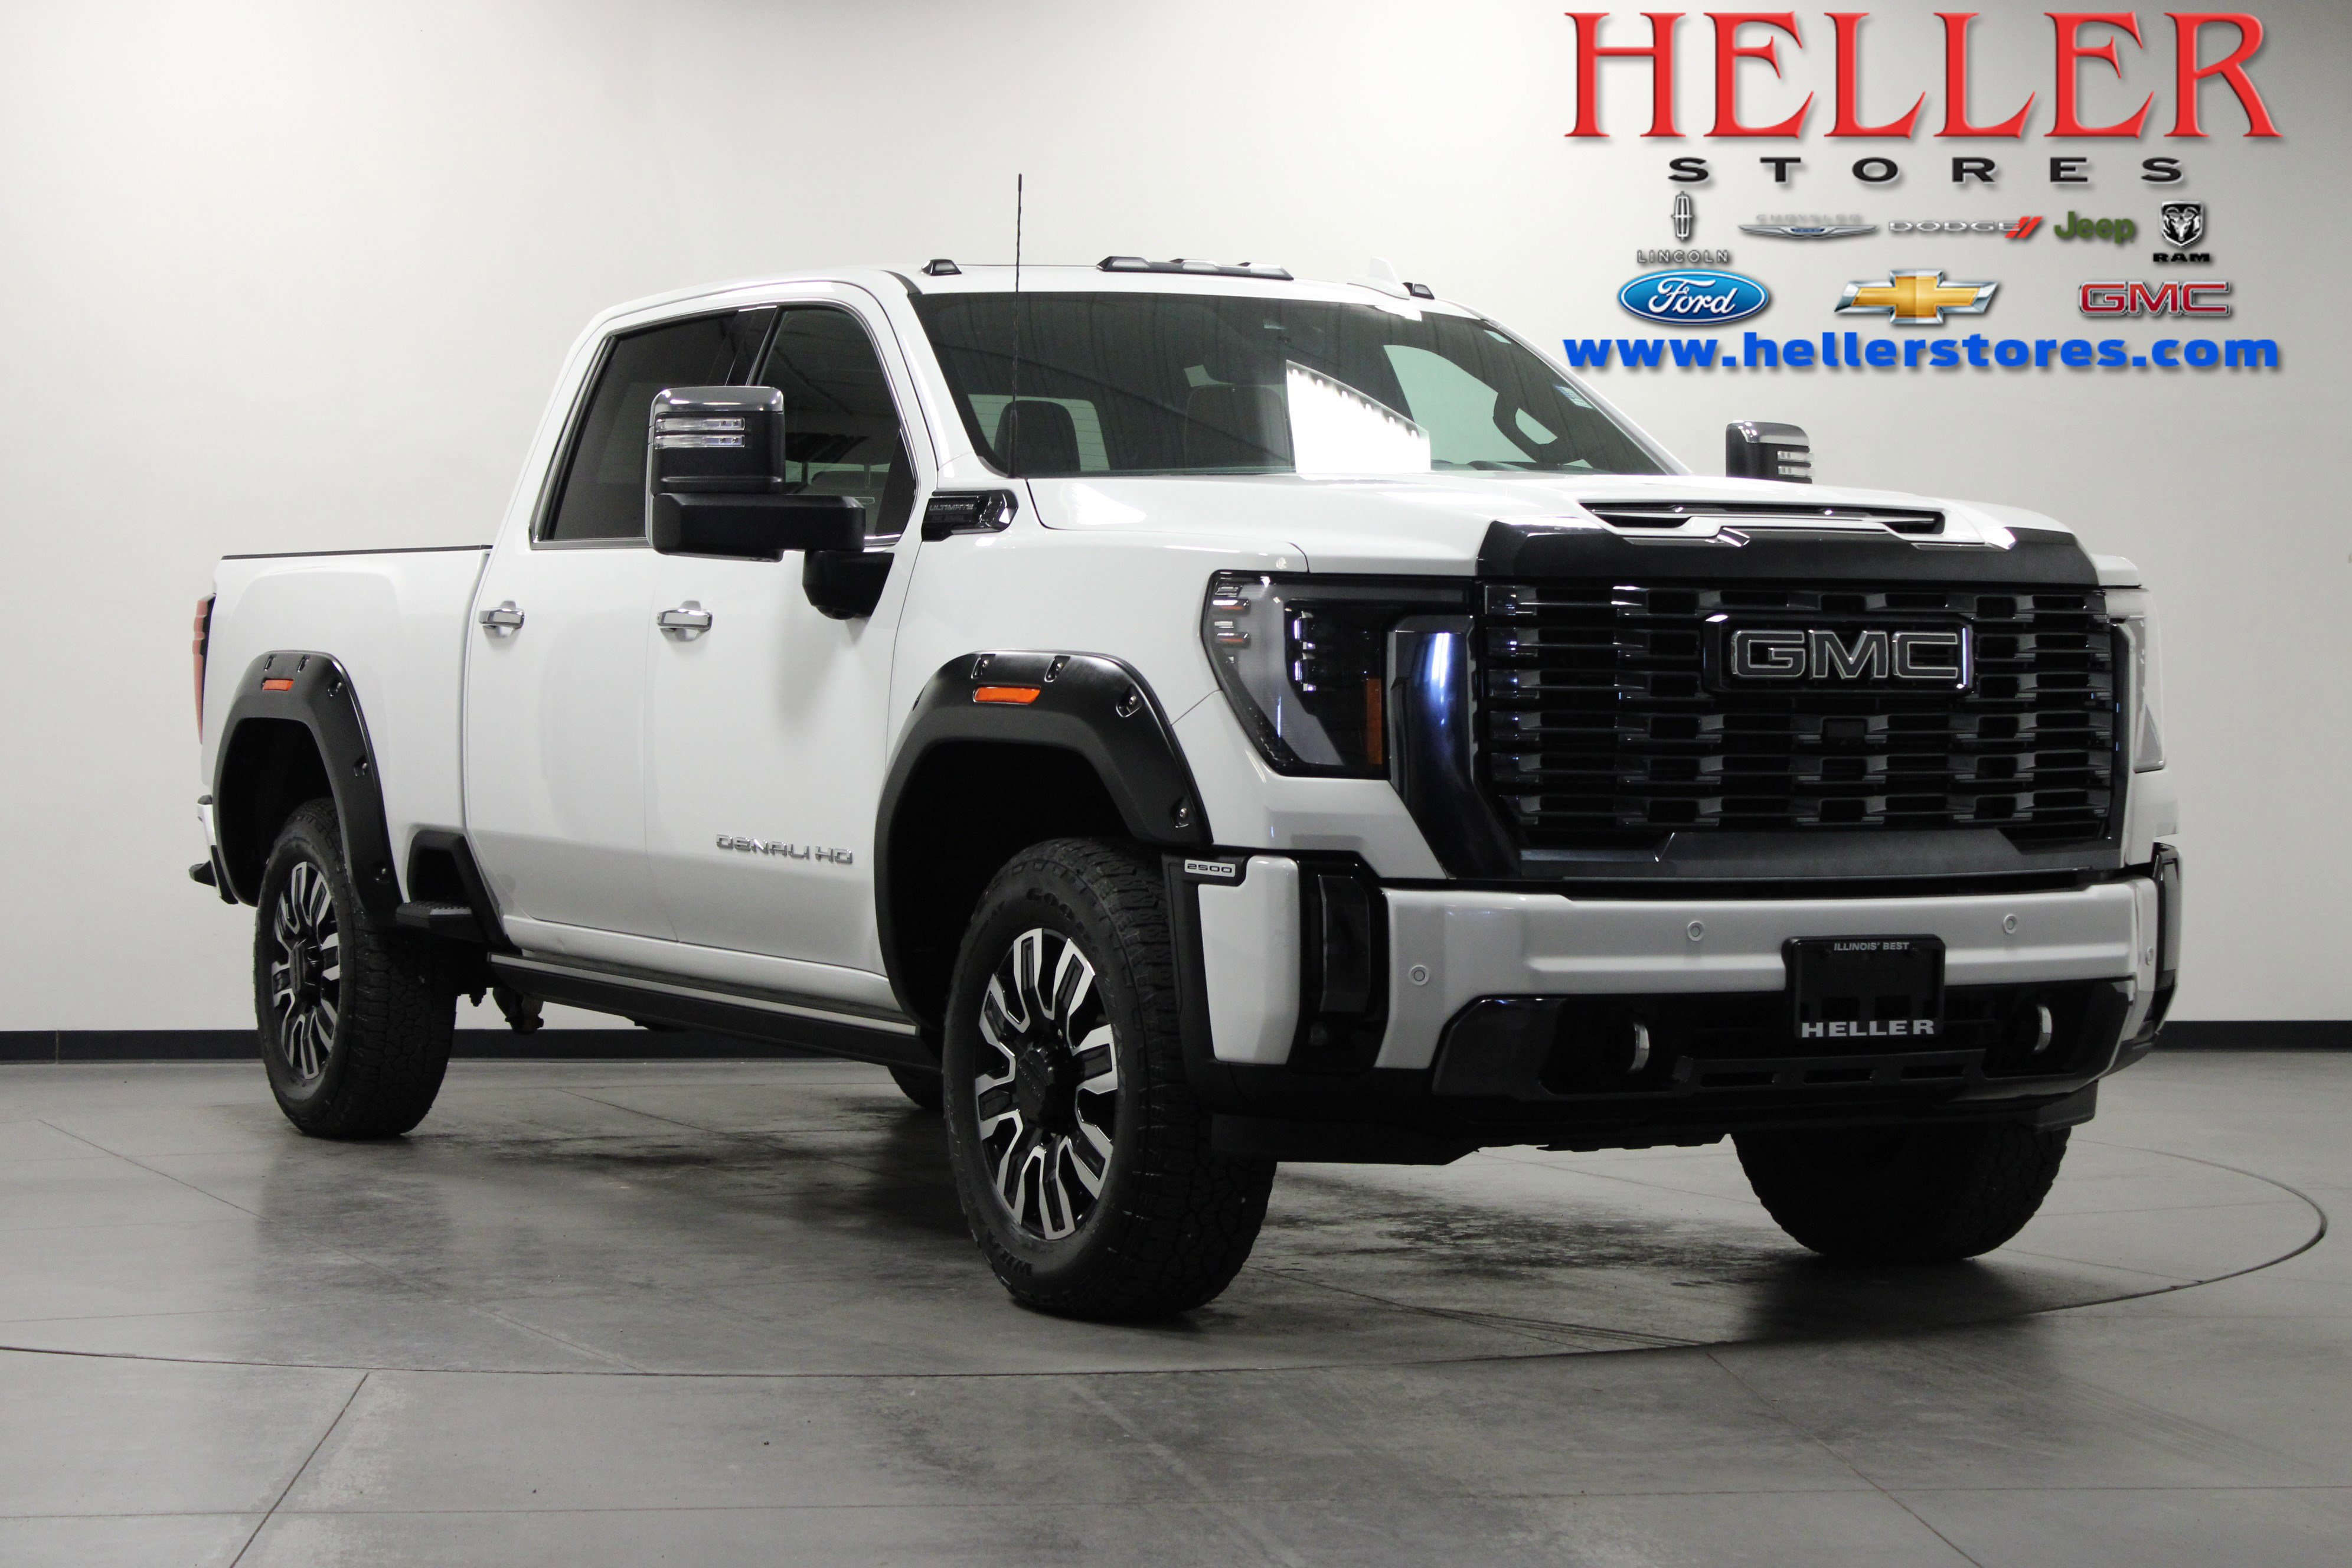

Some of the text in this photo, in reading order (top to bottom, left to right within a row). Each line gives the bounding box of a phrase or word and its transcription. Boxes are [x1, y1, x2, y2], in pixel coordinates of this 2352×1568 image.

[1730, 629, 1959, 680] GMC
[716, 834, 853, 864] DENALI HD
[1187, 863, 1232, 873] 2500
[1834, 942, 1910, 951] ILLINOIS' BEST
[1801, 1019, 1935, 1038] HELLER
